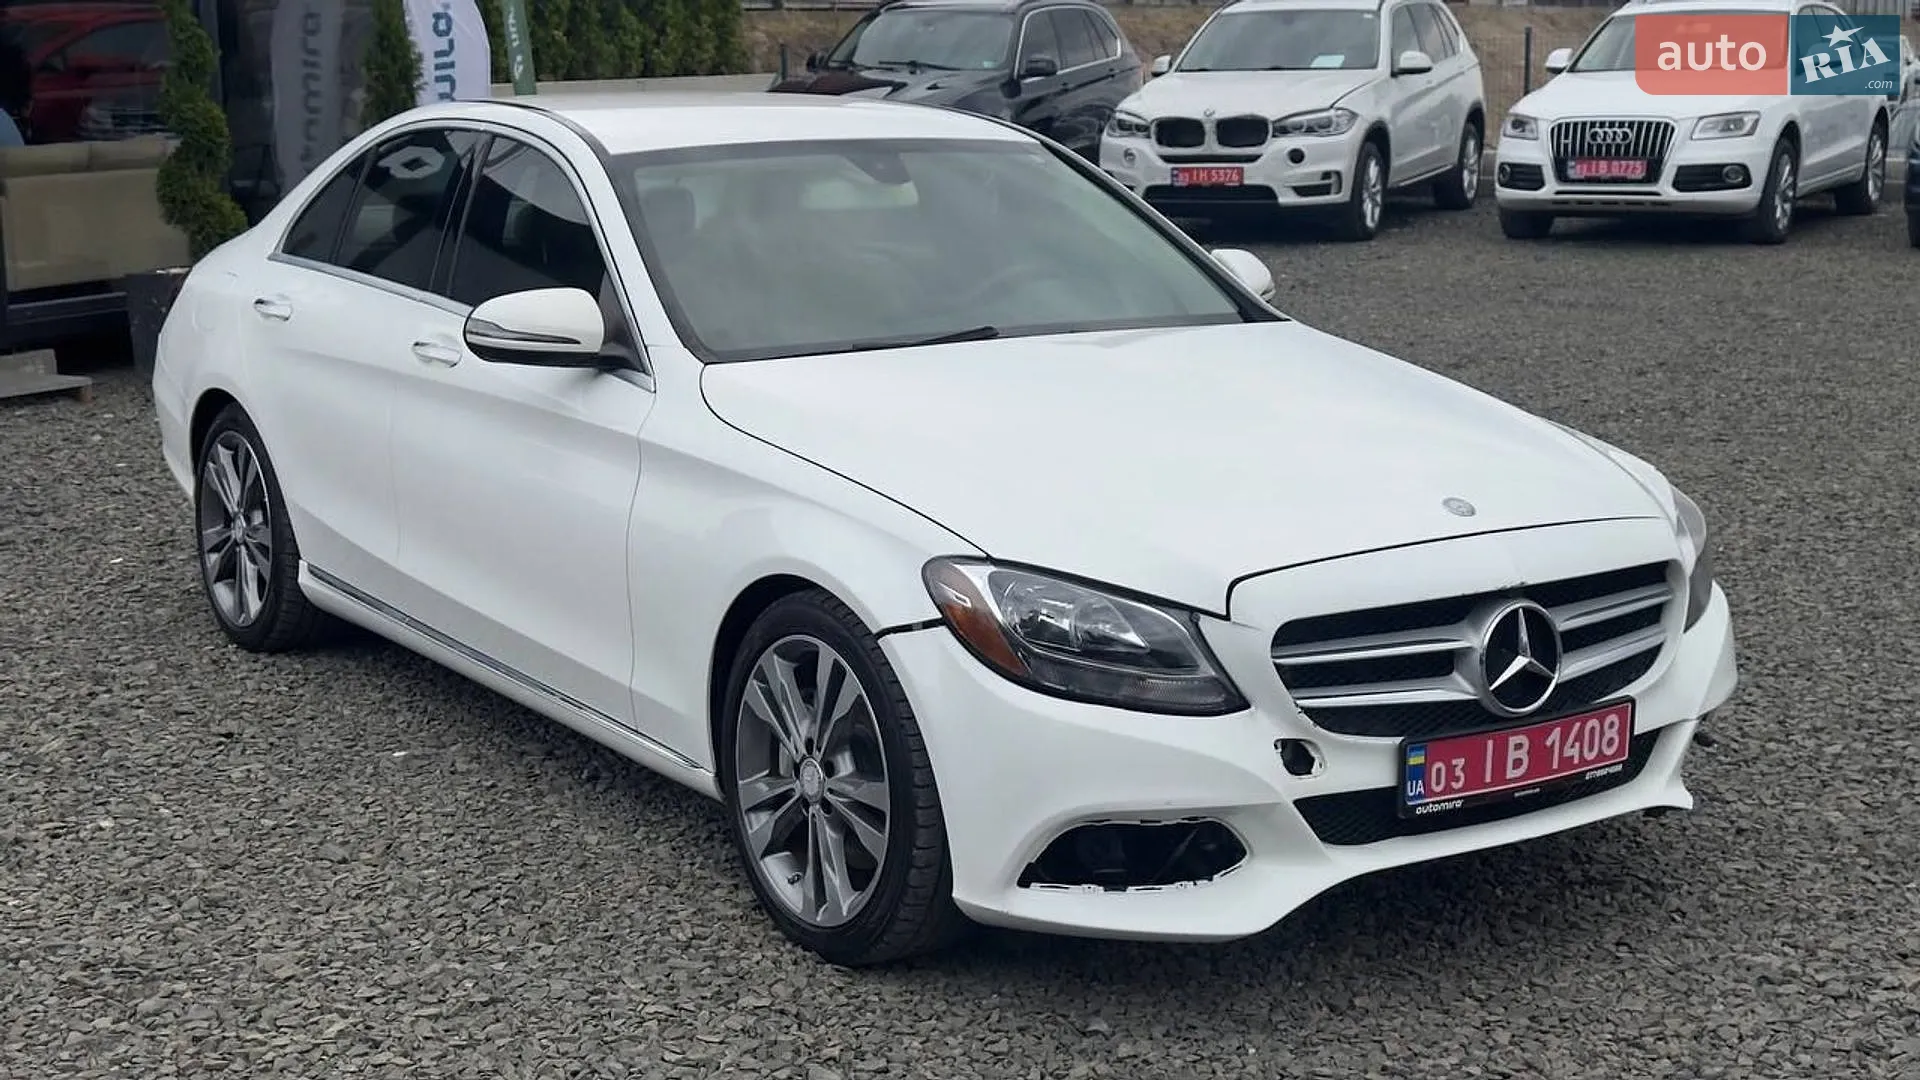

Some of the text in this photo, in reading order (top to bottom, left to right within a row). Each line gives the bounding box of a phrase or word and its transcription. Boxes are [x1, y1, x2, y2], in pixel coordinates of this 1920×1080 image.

[1430, 758, 1465, 793] 03
[1545, 714, 1620, 769] 1408
[1407, 780, 1425, 796] UA
